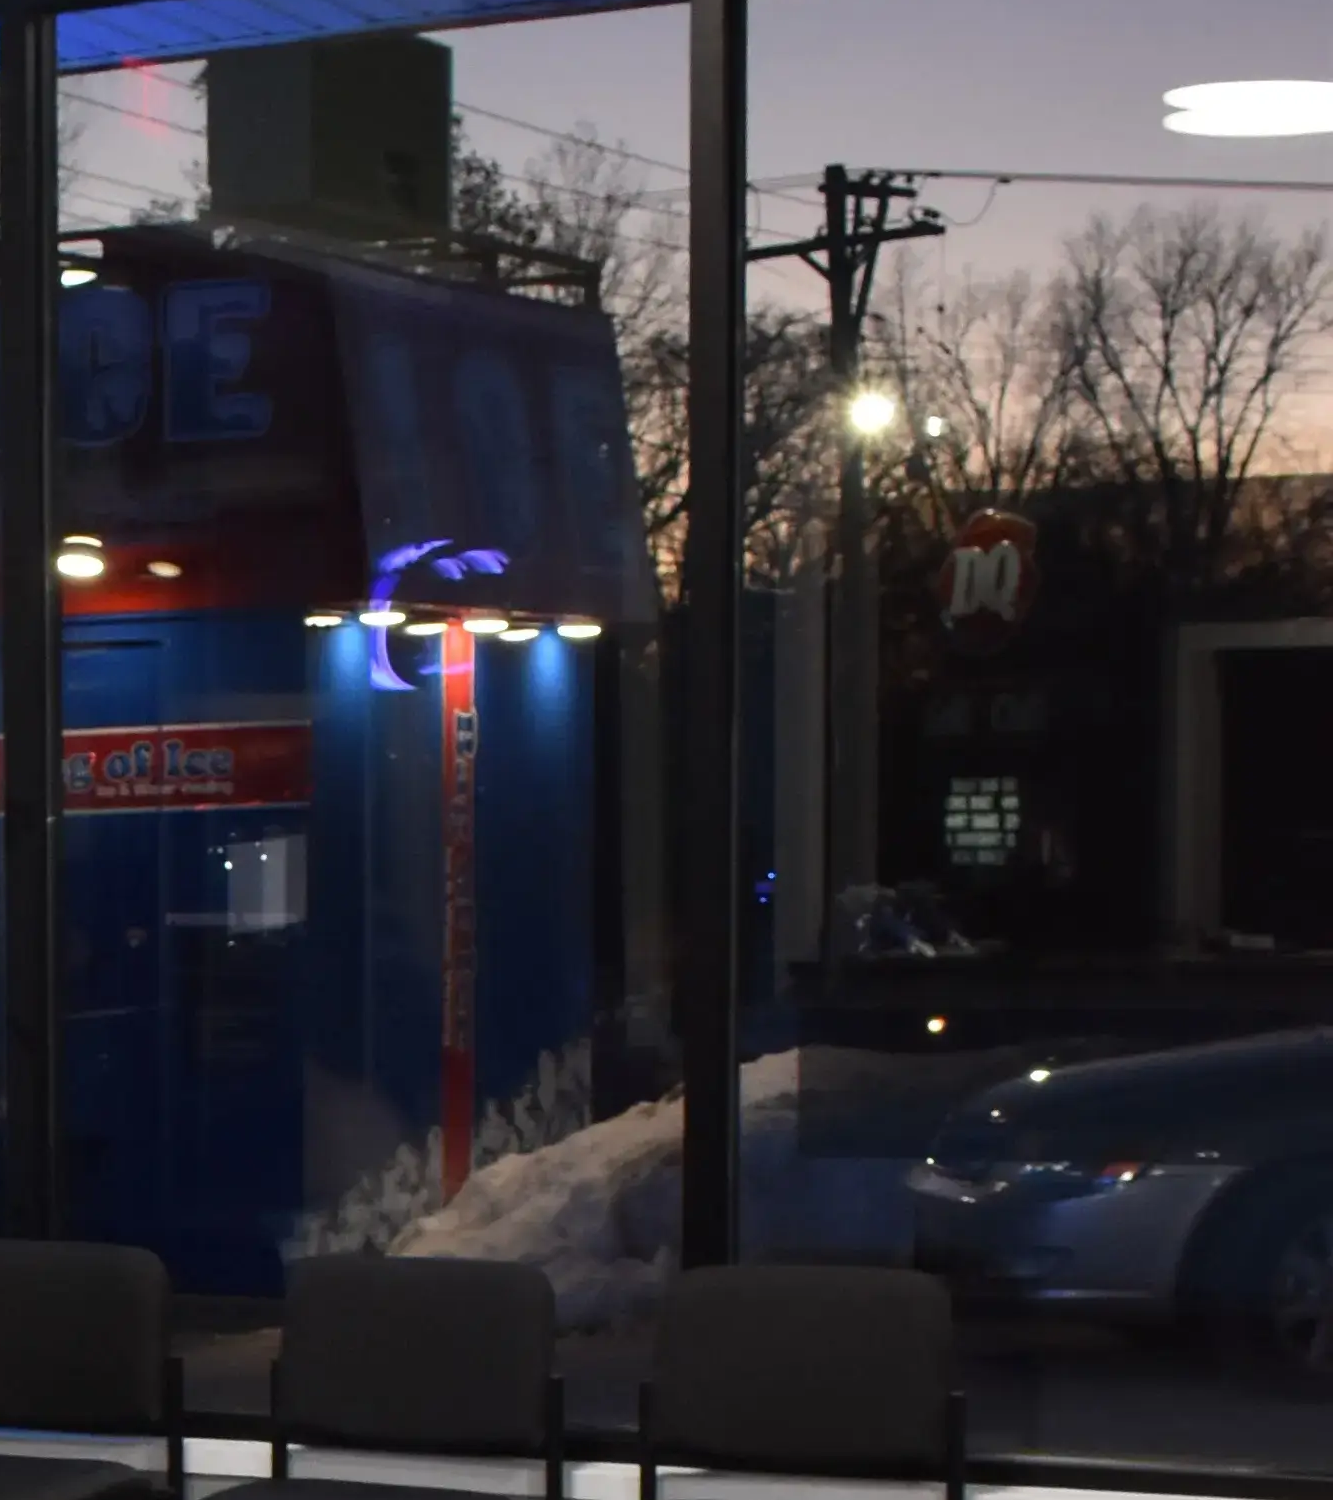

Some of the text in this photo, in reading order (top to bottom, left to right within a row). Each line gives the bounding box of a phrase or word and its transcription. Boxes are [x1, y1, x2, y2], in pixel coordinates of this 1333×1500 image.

[949, 544, 1022, 622] DQ
[103, 740, 154, 783] of
[162, 738, 235, 780] Ice
